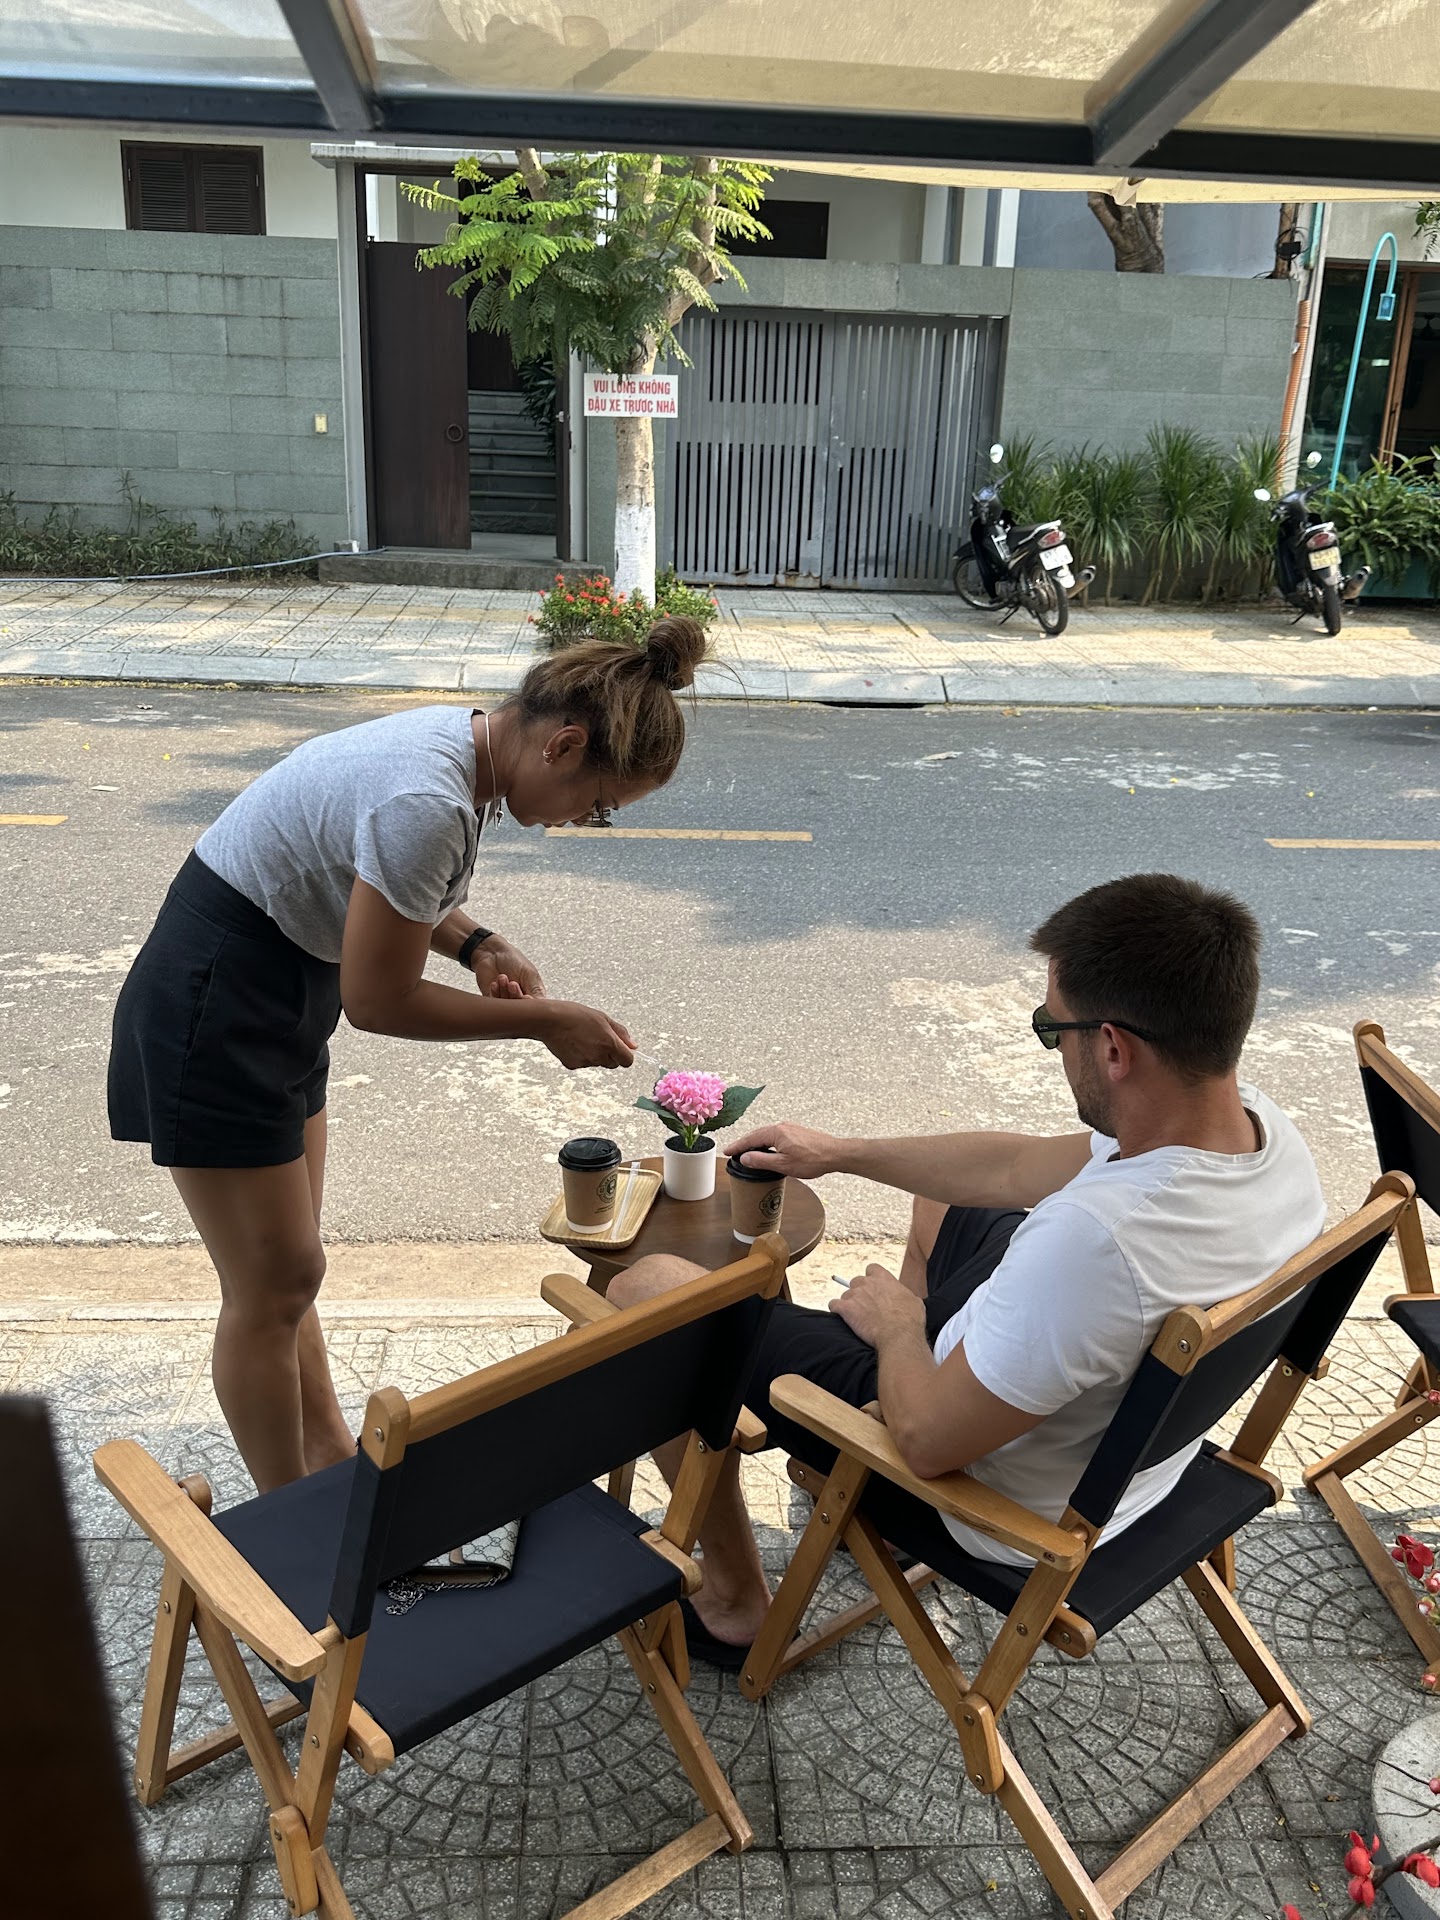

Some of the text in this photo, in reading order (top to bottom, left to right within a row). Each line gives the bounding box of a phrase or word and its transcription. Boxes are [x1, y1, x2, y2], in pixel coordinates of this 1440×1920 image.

[594, 380, 608, 393] VUI
[638, 379, 671, 395] KHÔNG
[588, 395, 607, 413] ĐẬU
[609, 399, 621, 412] XE
